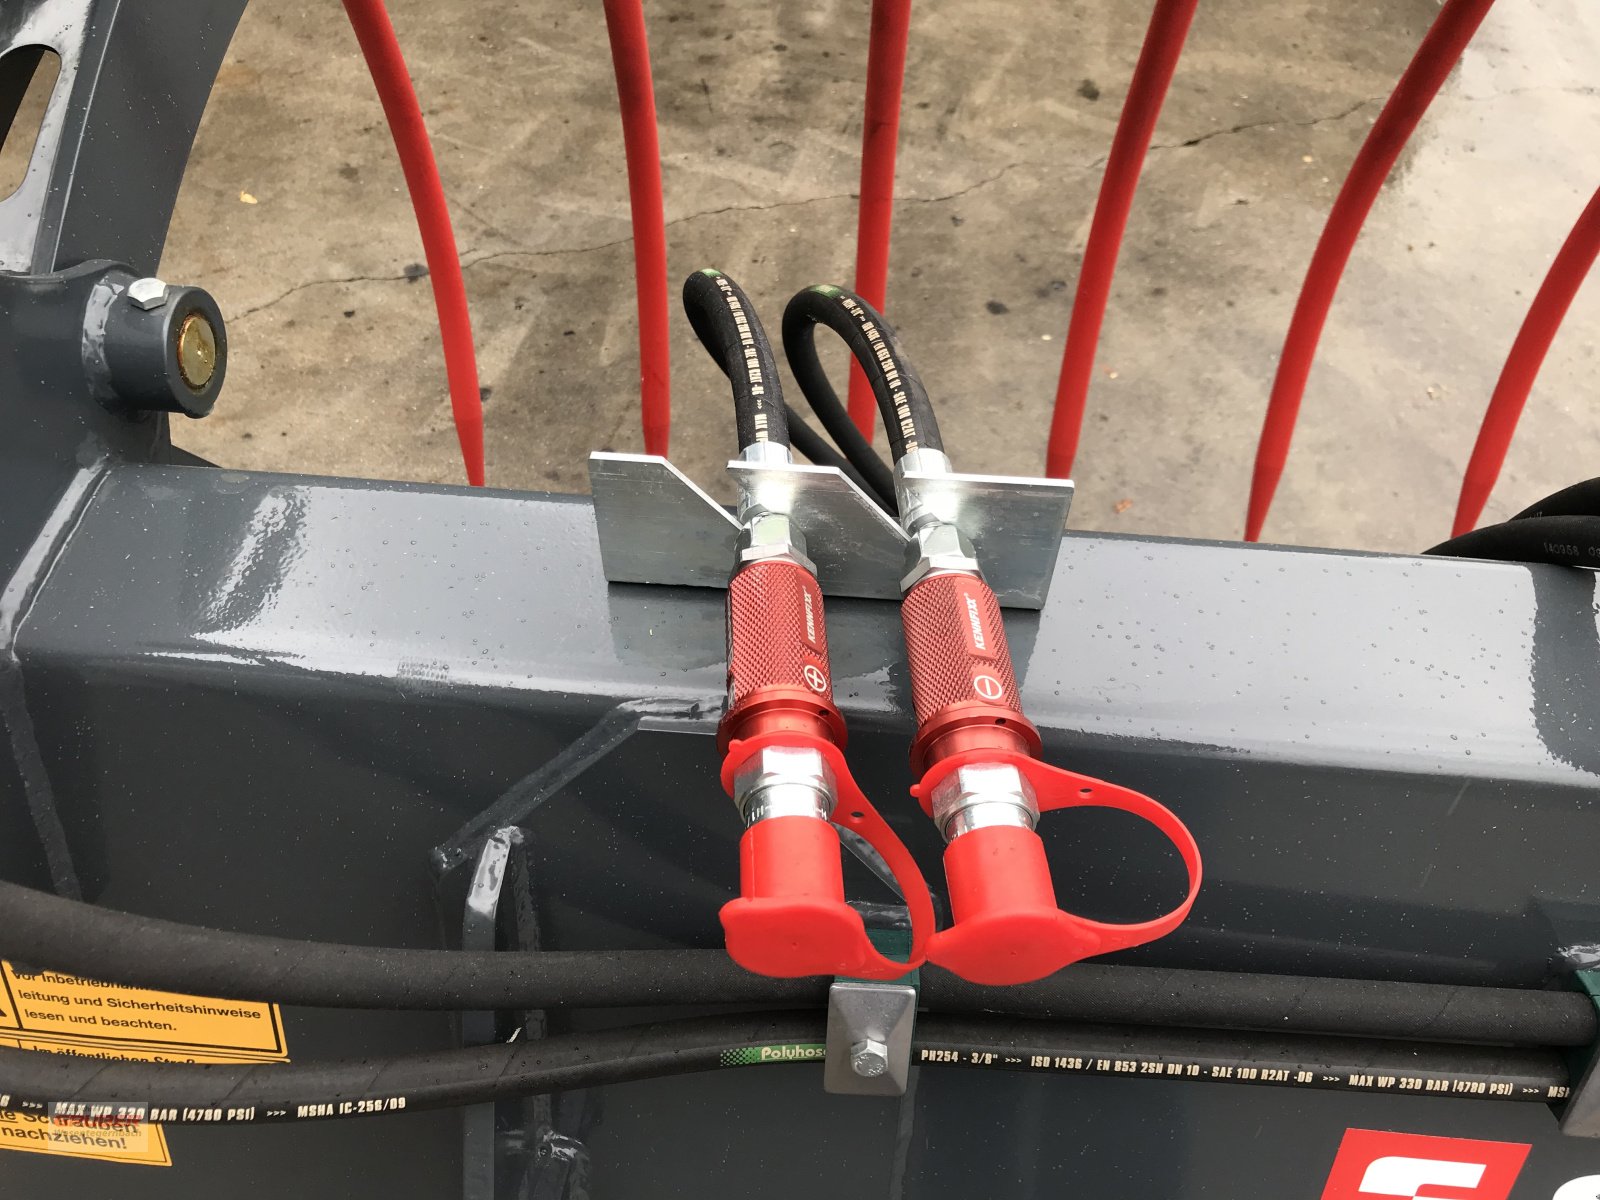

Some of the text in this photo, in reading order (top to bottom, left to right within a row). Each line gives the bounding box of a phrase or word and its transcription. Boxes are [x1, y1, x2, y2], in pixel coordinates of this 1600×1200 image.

[18, 989, 262, 1019] leitung und Sicherheitshinweise
[24, 1009, 177, 1031] lesen und beachten.
[761, 1045, 826, 1060] Polyhos
[920, 1049, 959, 1063] PH254
[1030, 1056, 1051, 1068] ISO
[1054, 1057, 1082, 1070] 1436
[1097, 1060, 1110, 1071] EN
[1114, 1061, 1137, 1073] 853
[1140, 1062, 1163, 1074] 2SN
[1167, 1063, 1183, 1075] DN
[1186, 1064, 1200, 1076] 10
[1211, 1066, 1234, 1078] SAE
[1237, 1068, 1257, 1080] 100
[1261, 1069, 1290, 1082] R2AT
[1348, 1074, 1374, 1088] MAX
[1377, 1076, 1396, 1088] WP
[1399, 1077, 1422, 1090] 330
[1425, 1079, 1449, 1092] BAR
[1489, 1082, 1513, 1096] PSI)
[54, 1101, 87, 1116] MAX
[90, 1104, 114, 1118] WP
[150, 1107, 177, 1121] BAR
[227, 1106, 255, 1121] PSI)
[297, 1104, 334, 1118] MSHA
[339, 1097, 406, 1115] IC-256/09
[2, 1126, 128, 1149] nachziehen!
